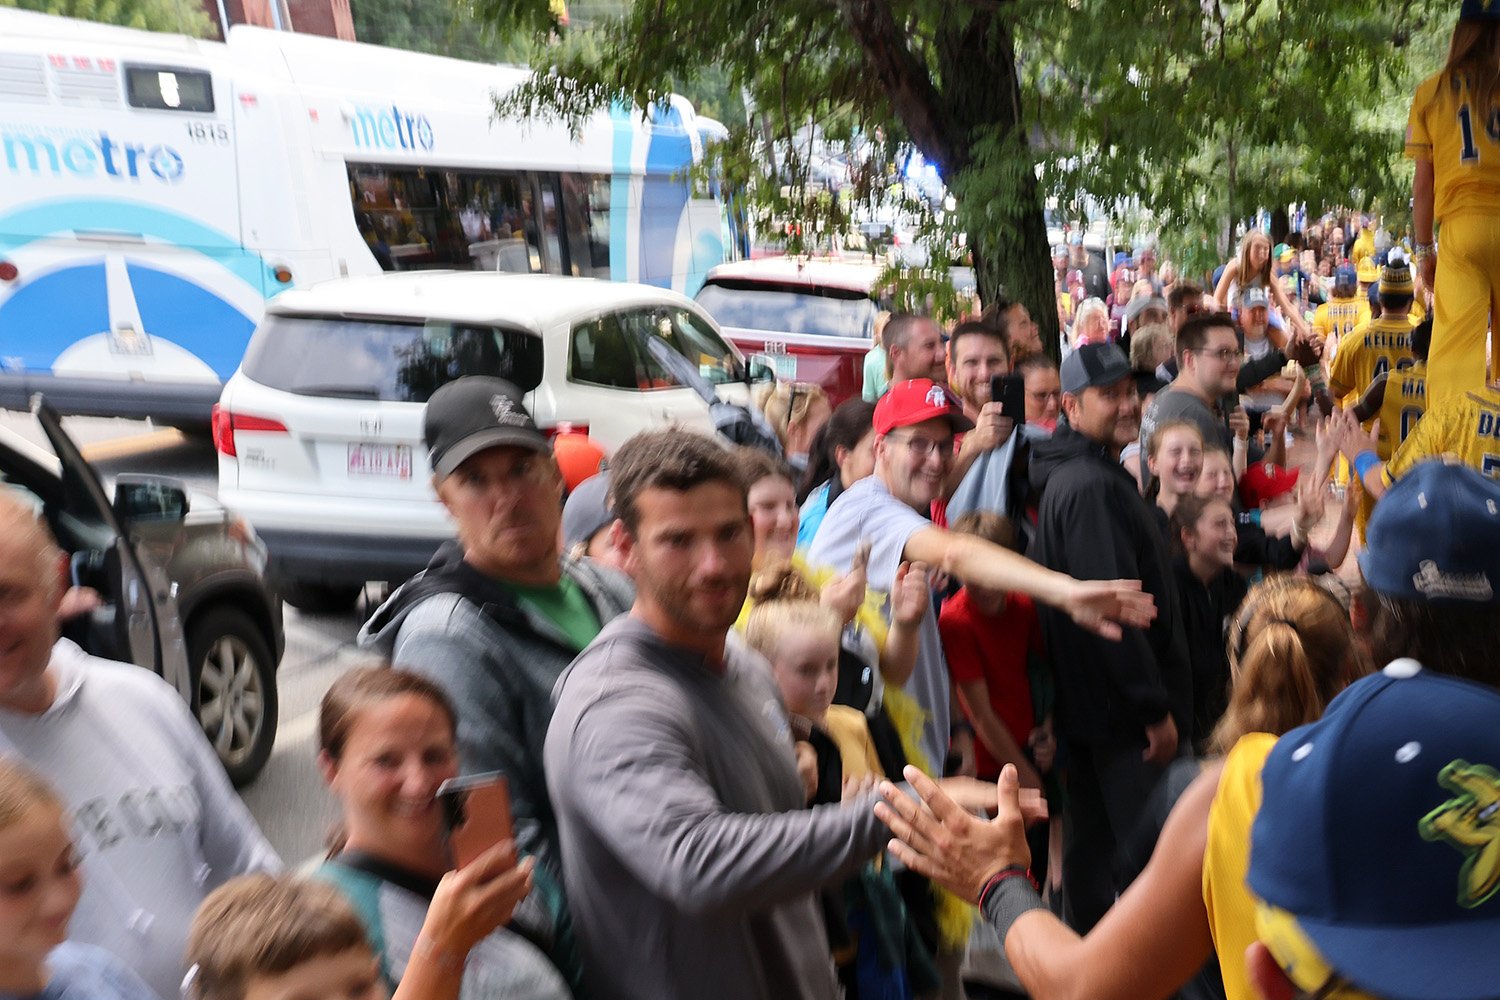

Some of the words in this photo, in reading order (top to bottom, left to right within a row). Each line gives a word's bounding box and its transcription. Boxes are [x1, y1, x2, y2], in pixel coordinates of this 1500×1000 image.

[185, 121, 229, 143] 1815
[352, 104, 434, 152] metro
[2, 130, 184, 184] metro
